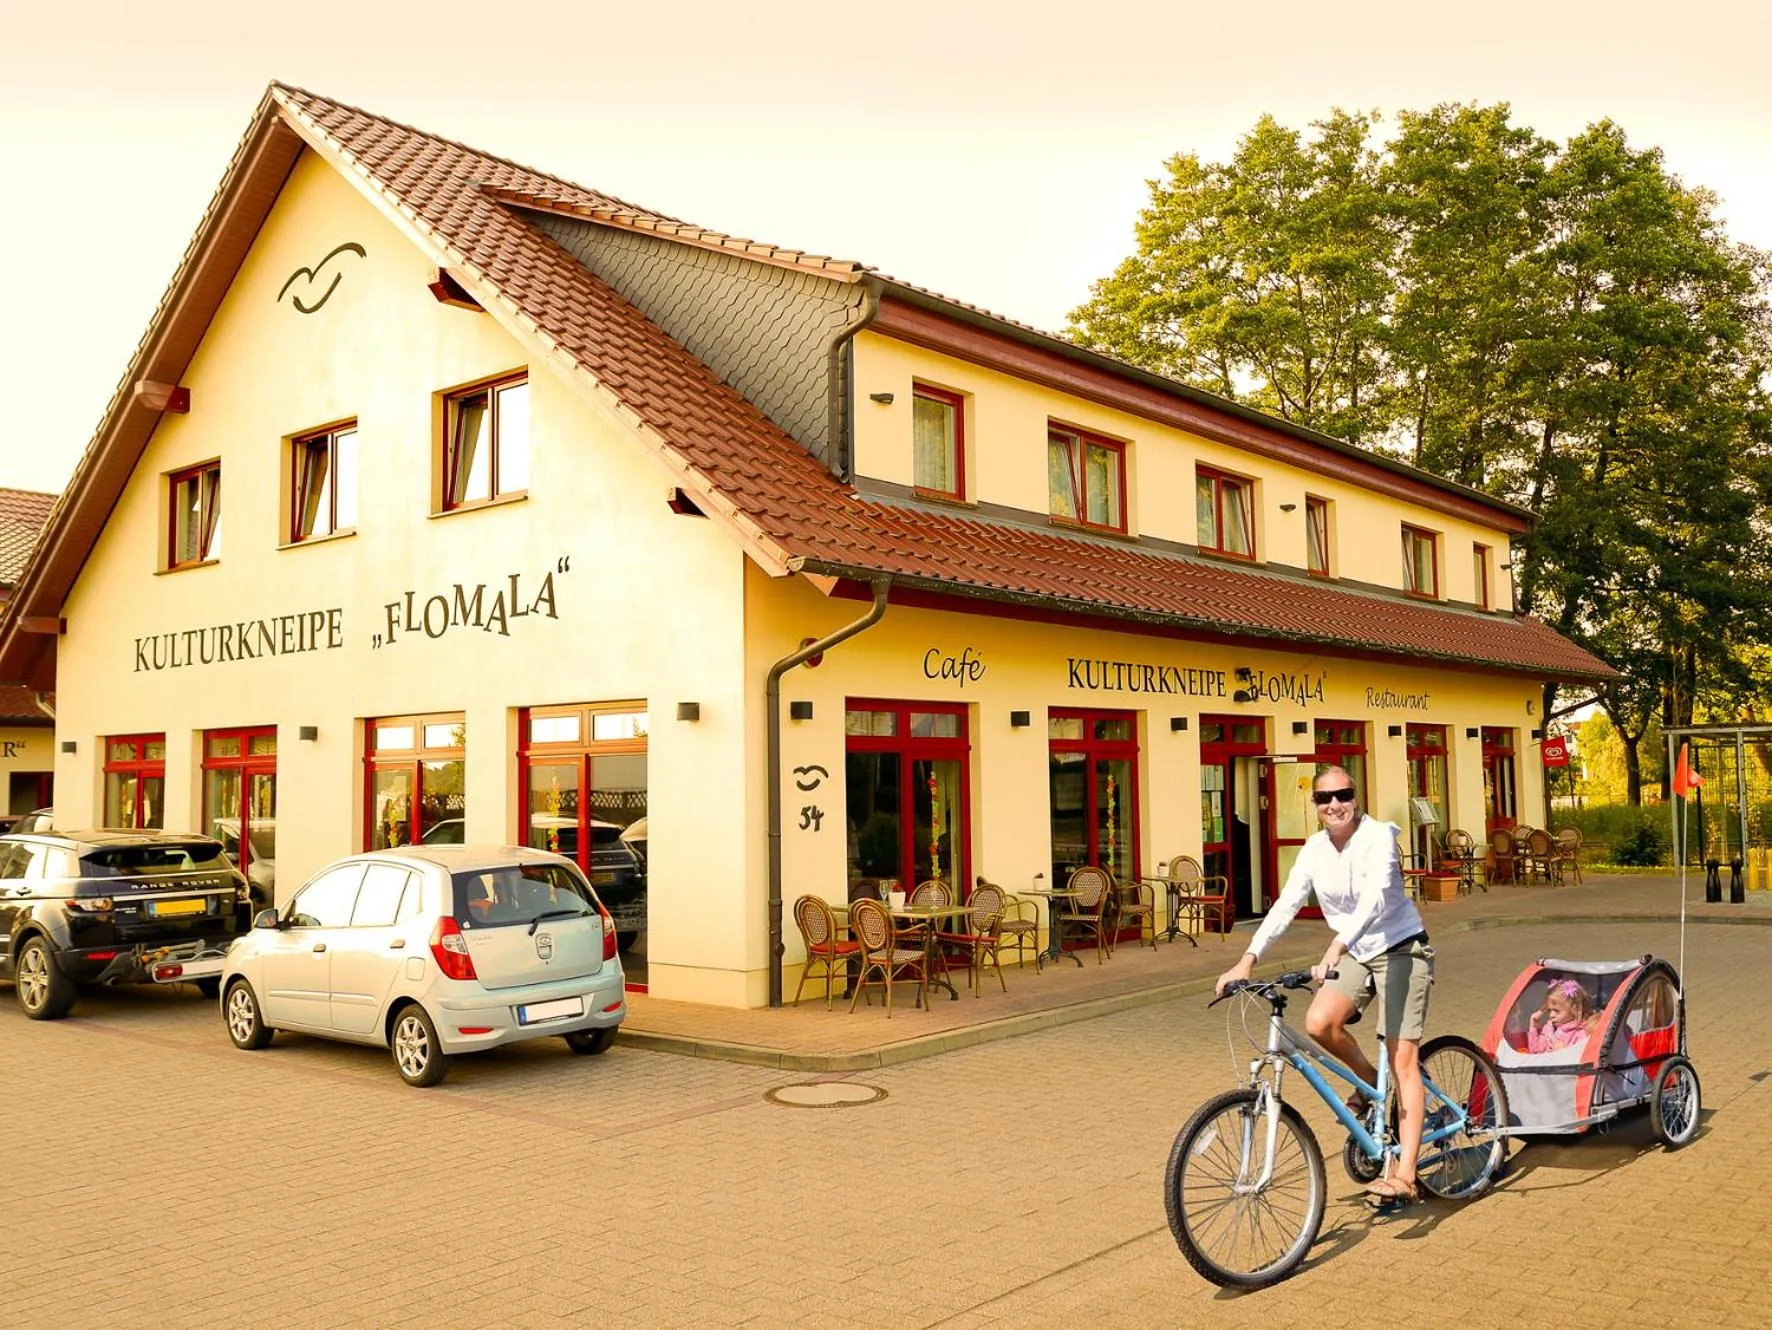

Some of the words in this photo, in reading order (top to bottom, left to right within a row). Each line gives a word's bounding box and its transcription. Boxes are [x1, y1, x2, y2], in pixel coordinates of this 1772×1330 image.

[133, 607, 344, 673] KULTURKNEIPE
[371, 554, 571, 650] „FLOMALA“
[922, 646, 987, 688] Café
[1066, 657, 1227, 698] KULTURKNEIPE
[1365, 686, 1431, 711] Restaurant
[798, 804, 825, 832] 54
[130, 881, 175, 890] RANGE
[181, 878, 221, 887] ROVER
